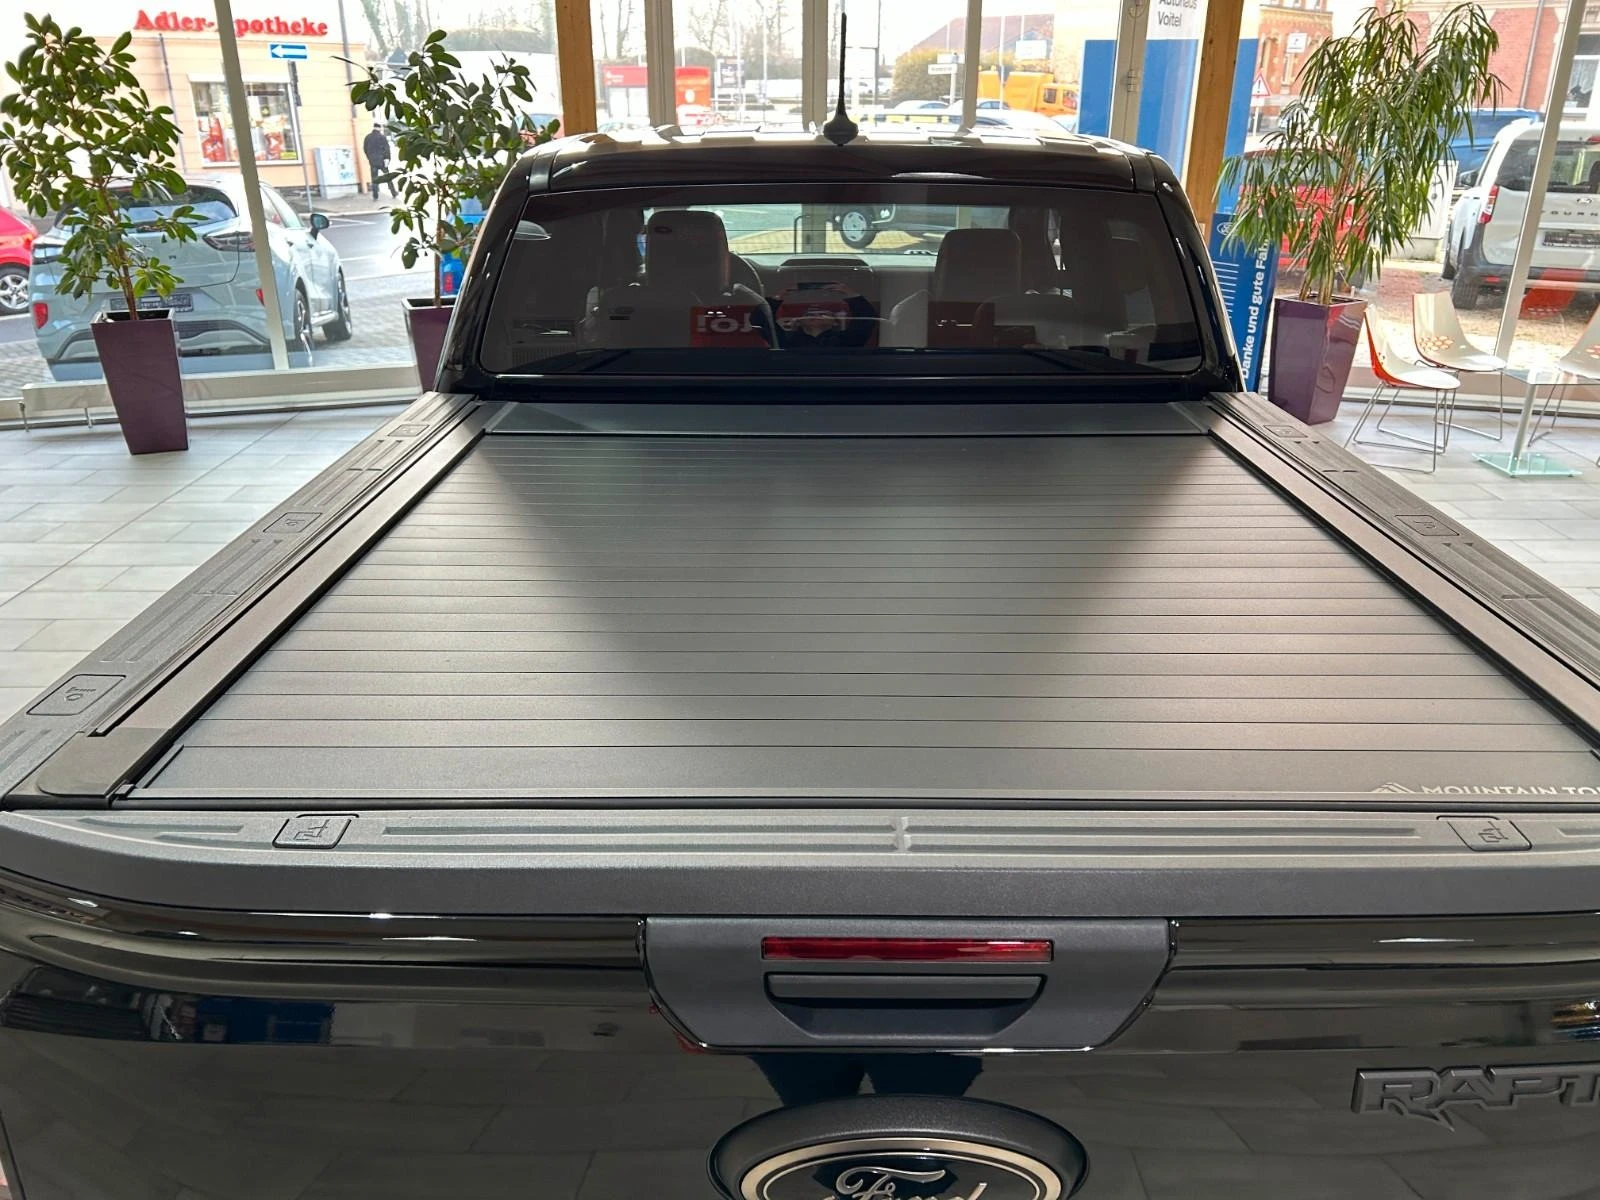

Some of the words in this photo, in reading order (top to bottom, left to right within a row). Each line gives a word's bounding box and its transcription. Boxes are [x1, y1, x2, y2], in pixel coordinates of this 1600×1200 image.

[134, 9, 328, 38] Adler-potheke
[1158, 11, 1182, 27] Voitel
[1251, 272, 1264, 305] gute
[1247, 306, 1260, 334] und
[1241, 335, 1255, 379] Danke
